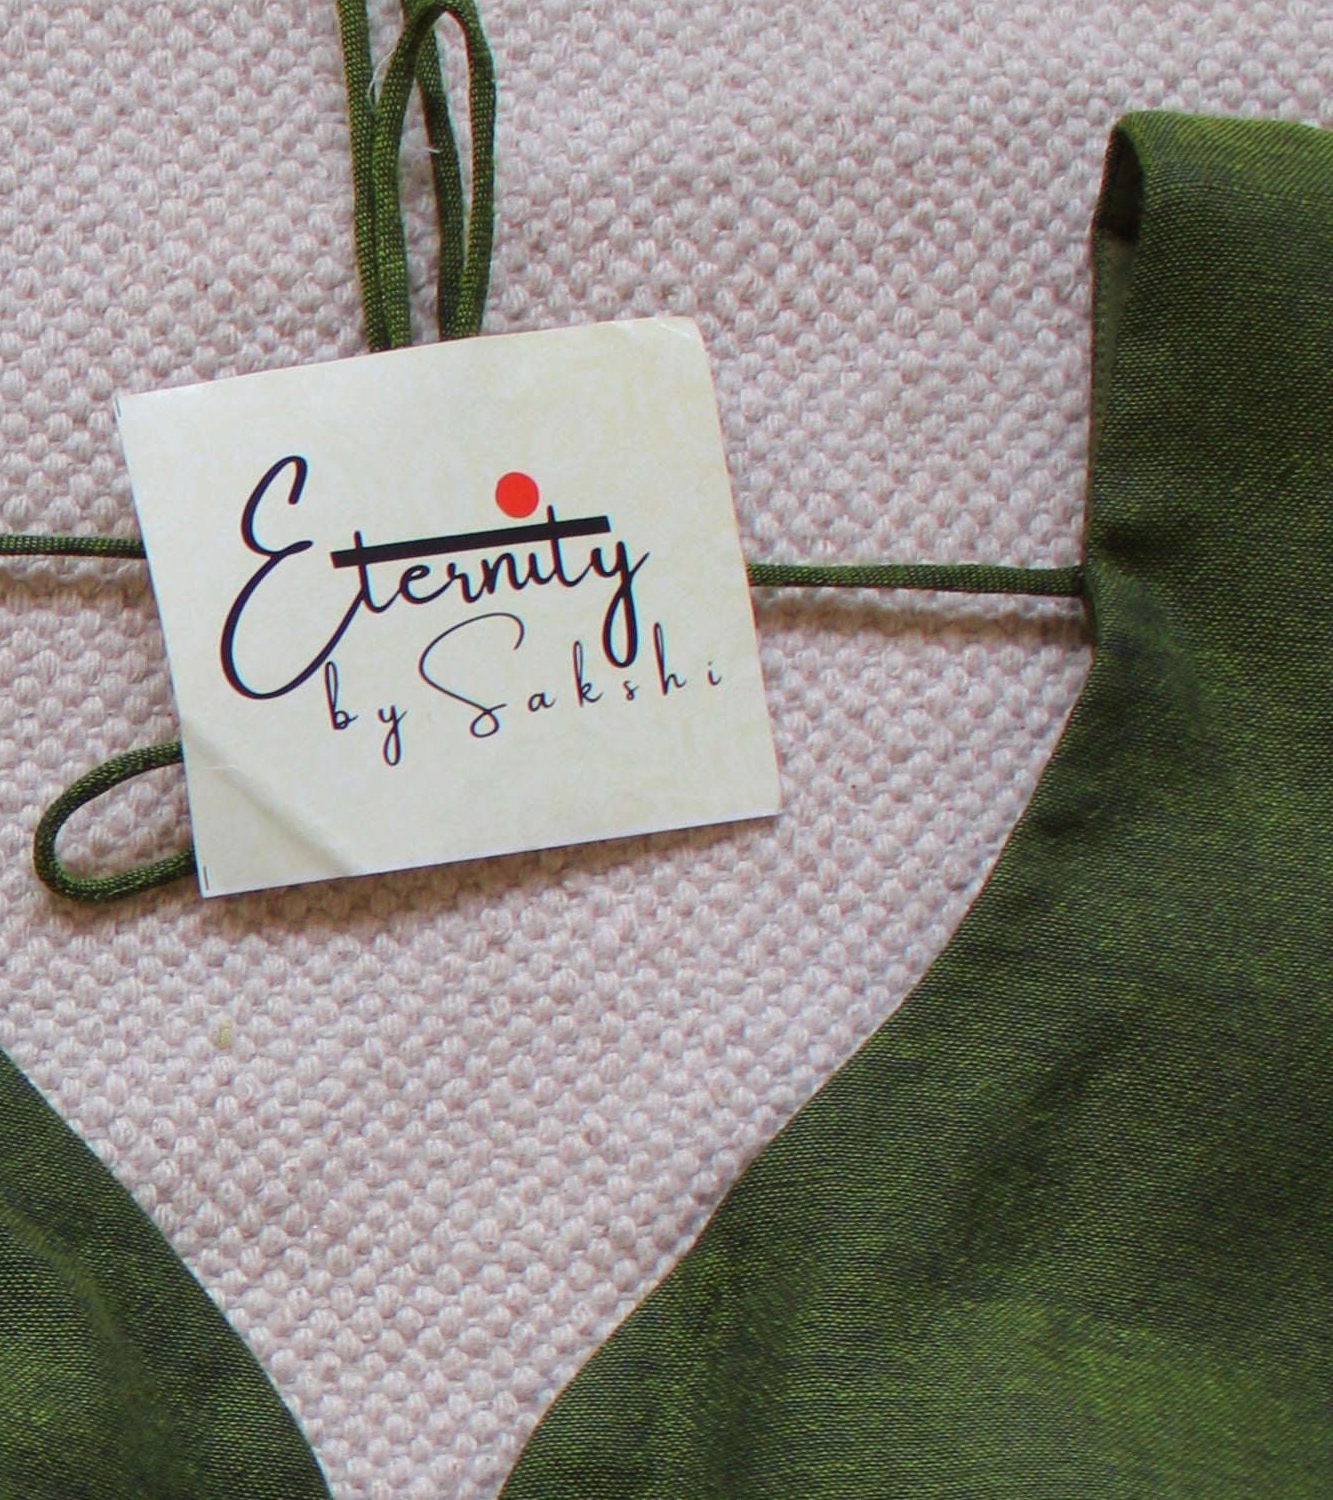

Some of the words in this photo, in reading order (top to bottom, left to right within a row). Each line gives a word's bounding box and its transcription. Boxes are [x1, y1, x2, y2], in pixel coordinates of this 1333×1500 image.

[220, 455, 650, 700] Eternity
[324, 660, 407, 767] by
[418, 612, 723, 739] Sakshi
